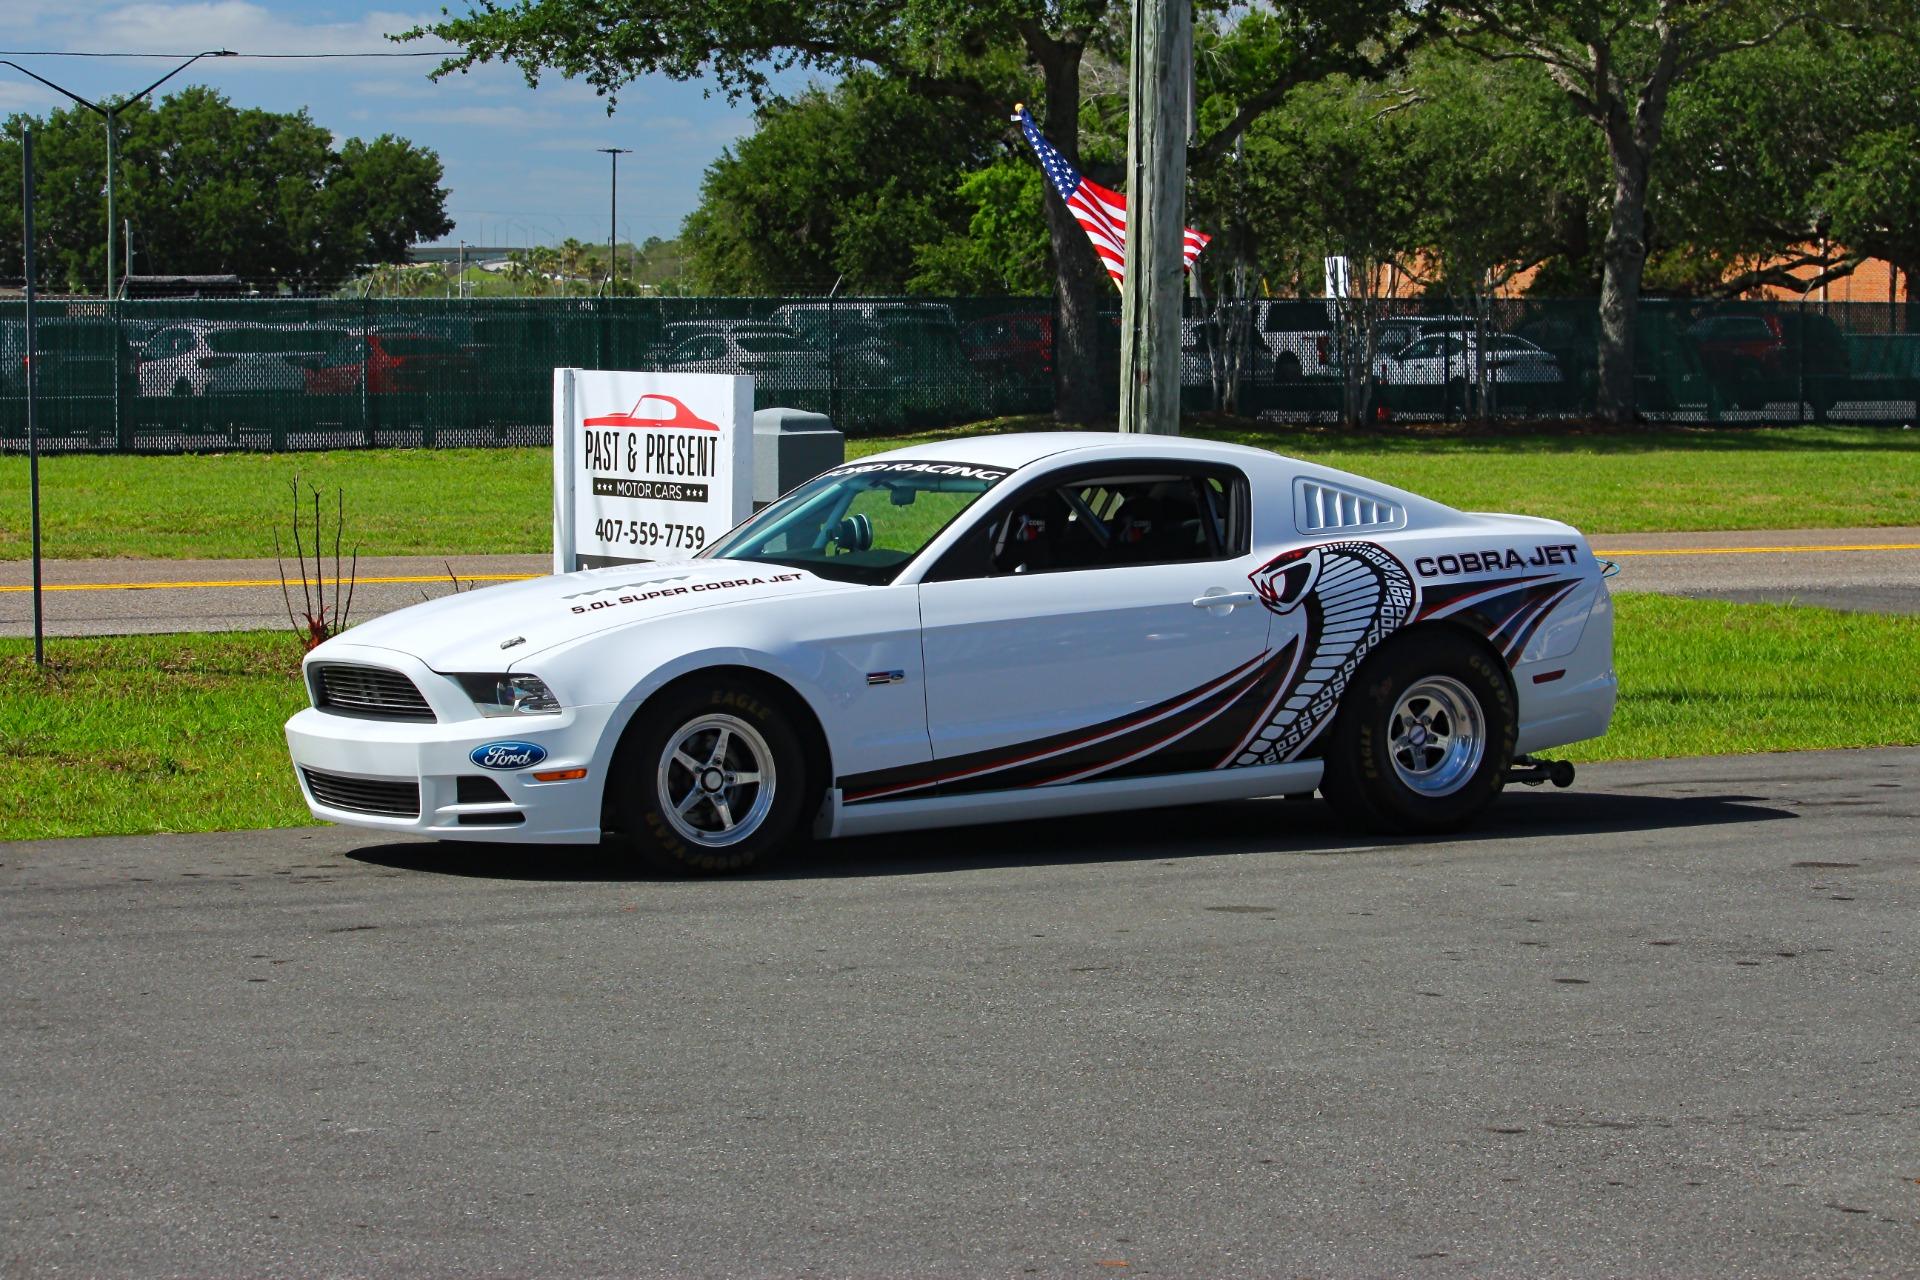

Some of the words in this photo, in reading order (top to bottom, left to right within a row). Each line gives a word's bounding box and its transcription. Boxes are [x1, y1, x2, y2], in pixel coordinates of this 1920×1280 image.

[585, 430, 620, 472] PAST
[628, 432, 637, 472] &
[646, 433, 718, 477] PRESENT
[886, 463, 1006, 481] RACING
[616, 481, 652, 498] MOTOR
[654, 484, 682, 500] CARS
[595, 518, 705, 550] 407-559-7759
[1414, 548, 1526, 578] COBRA
[1528, 544, 1577, 567] JET
[571, 600, 616, 615] 5.0L
[618, 587, 689, 604] SUPER
[691, 577, 765, 592] COBRA
[769, 573, 803, 583] JET
[712, 689, 769, 720] EAGLE
[484, 745, 531, 765] Ford
